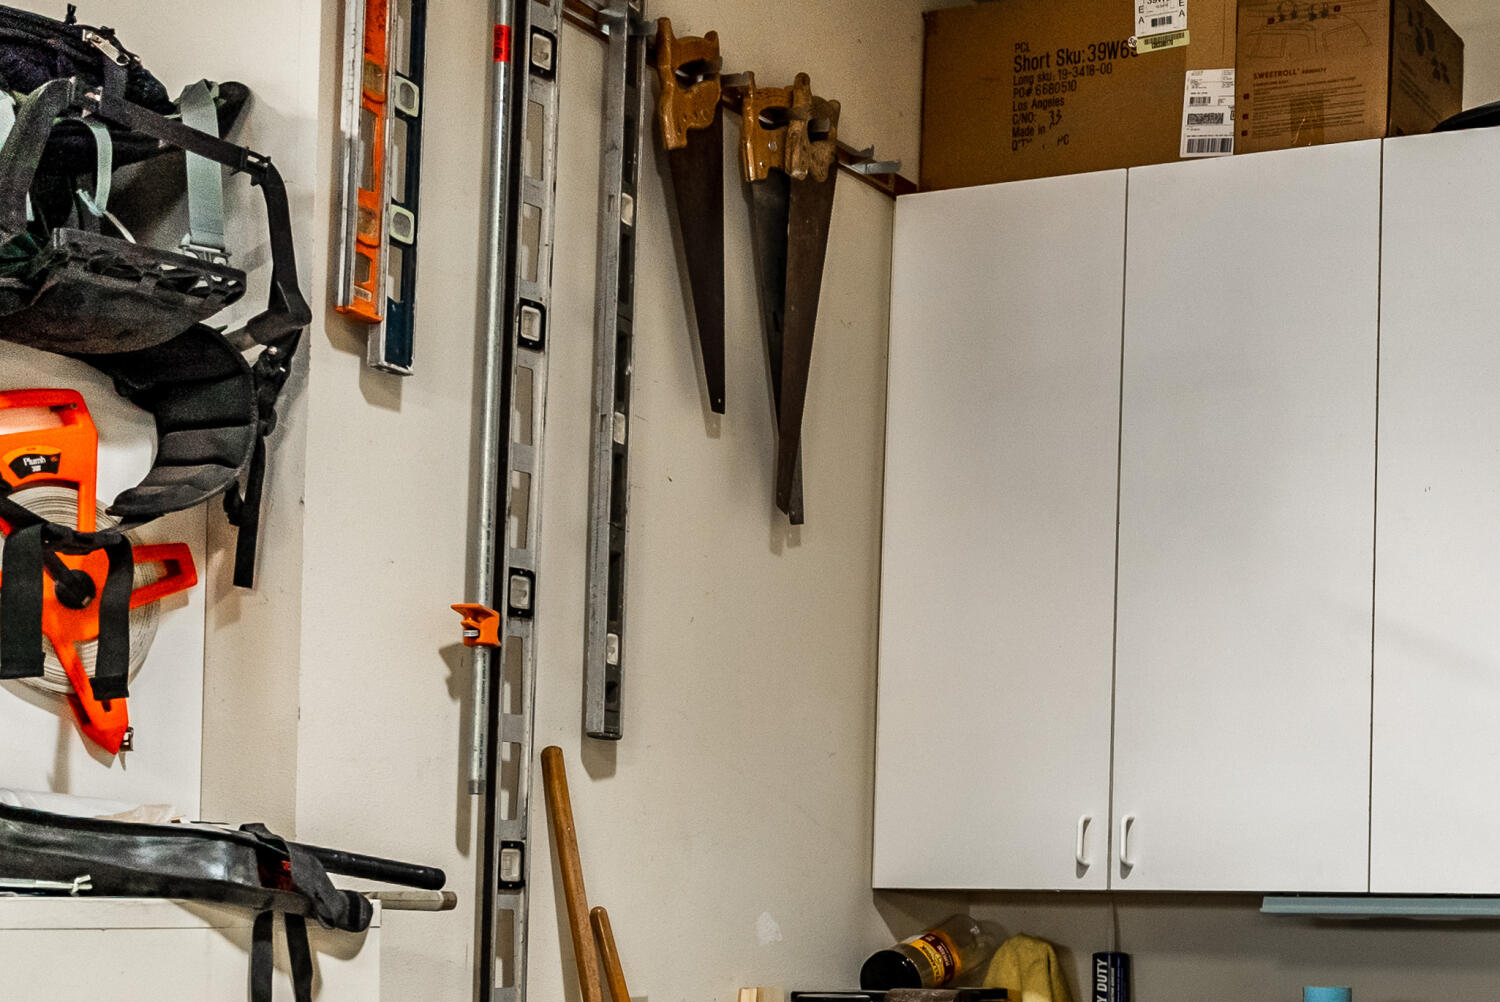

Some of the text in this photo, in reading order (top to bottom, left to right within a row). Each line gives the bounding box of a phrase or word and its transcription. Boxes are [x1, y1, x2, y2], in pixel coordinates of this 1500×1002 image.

[1013, 52, 1051, 73] Short
[1013, 74, 1034, 87] Long
[1058, 62, 1113, 80] 19-3418-00
[1035, 80, 1077, 96] 6680510
[1012, 97, 1065, 112] Los Angeles
[1012, 125, 1046, 138] Made in
[1096, 958, 1109, 994] DUTY
